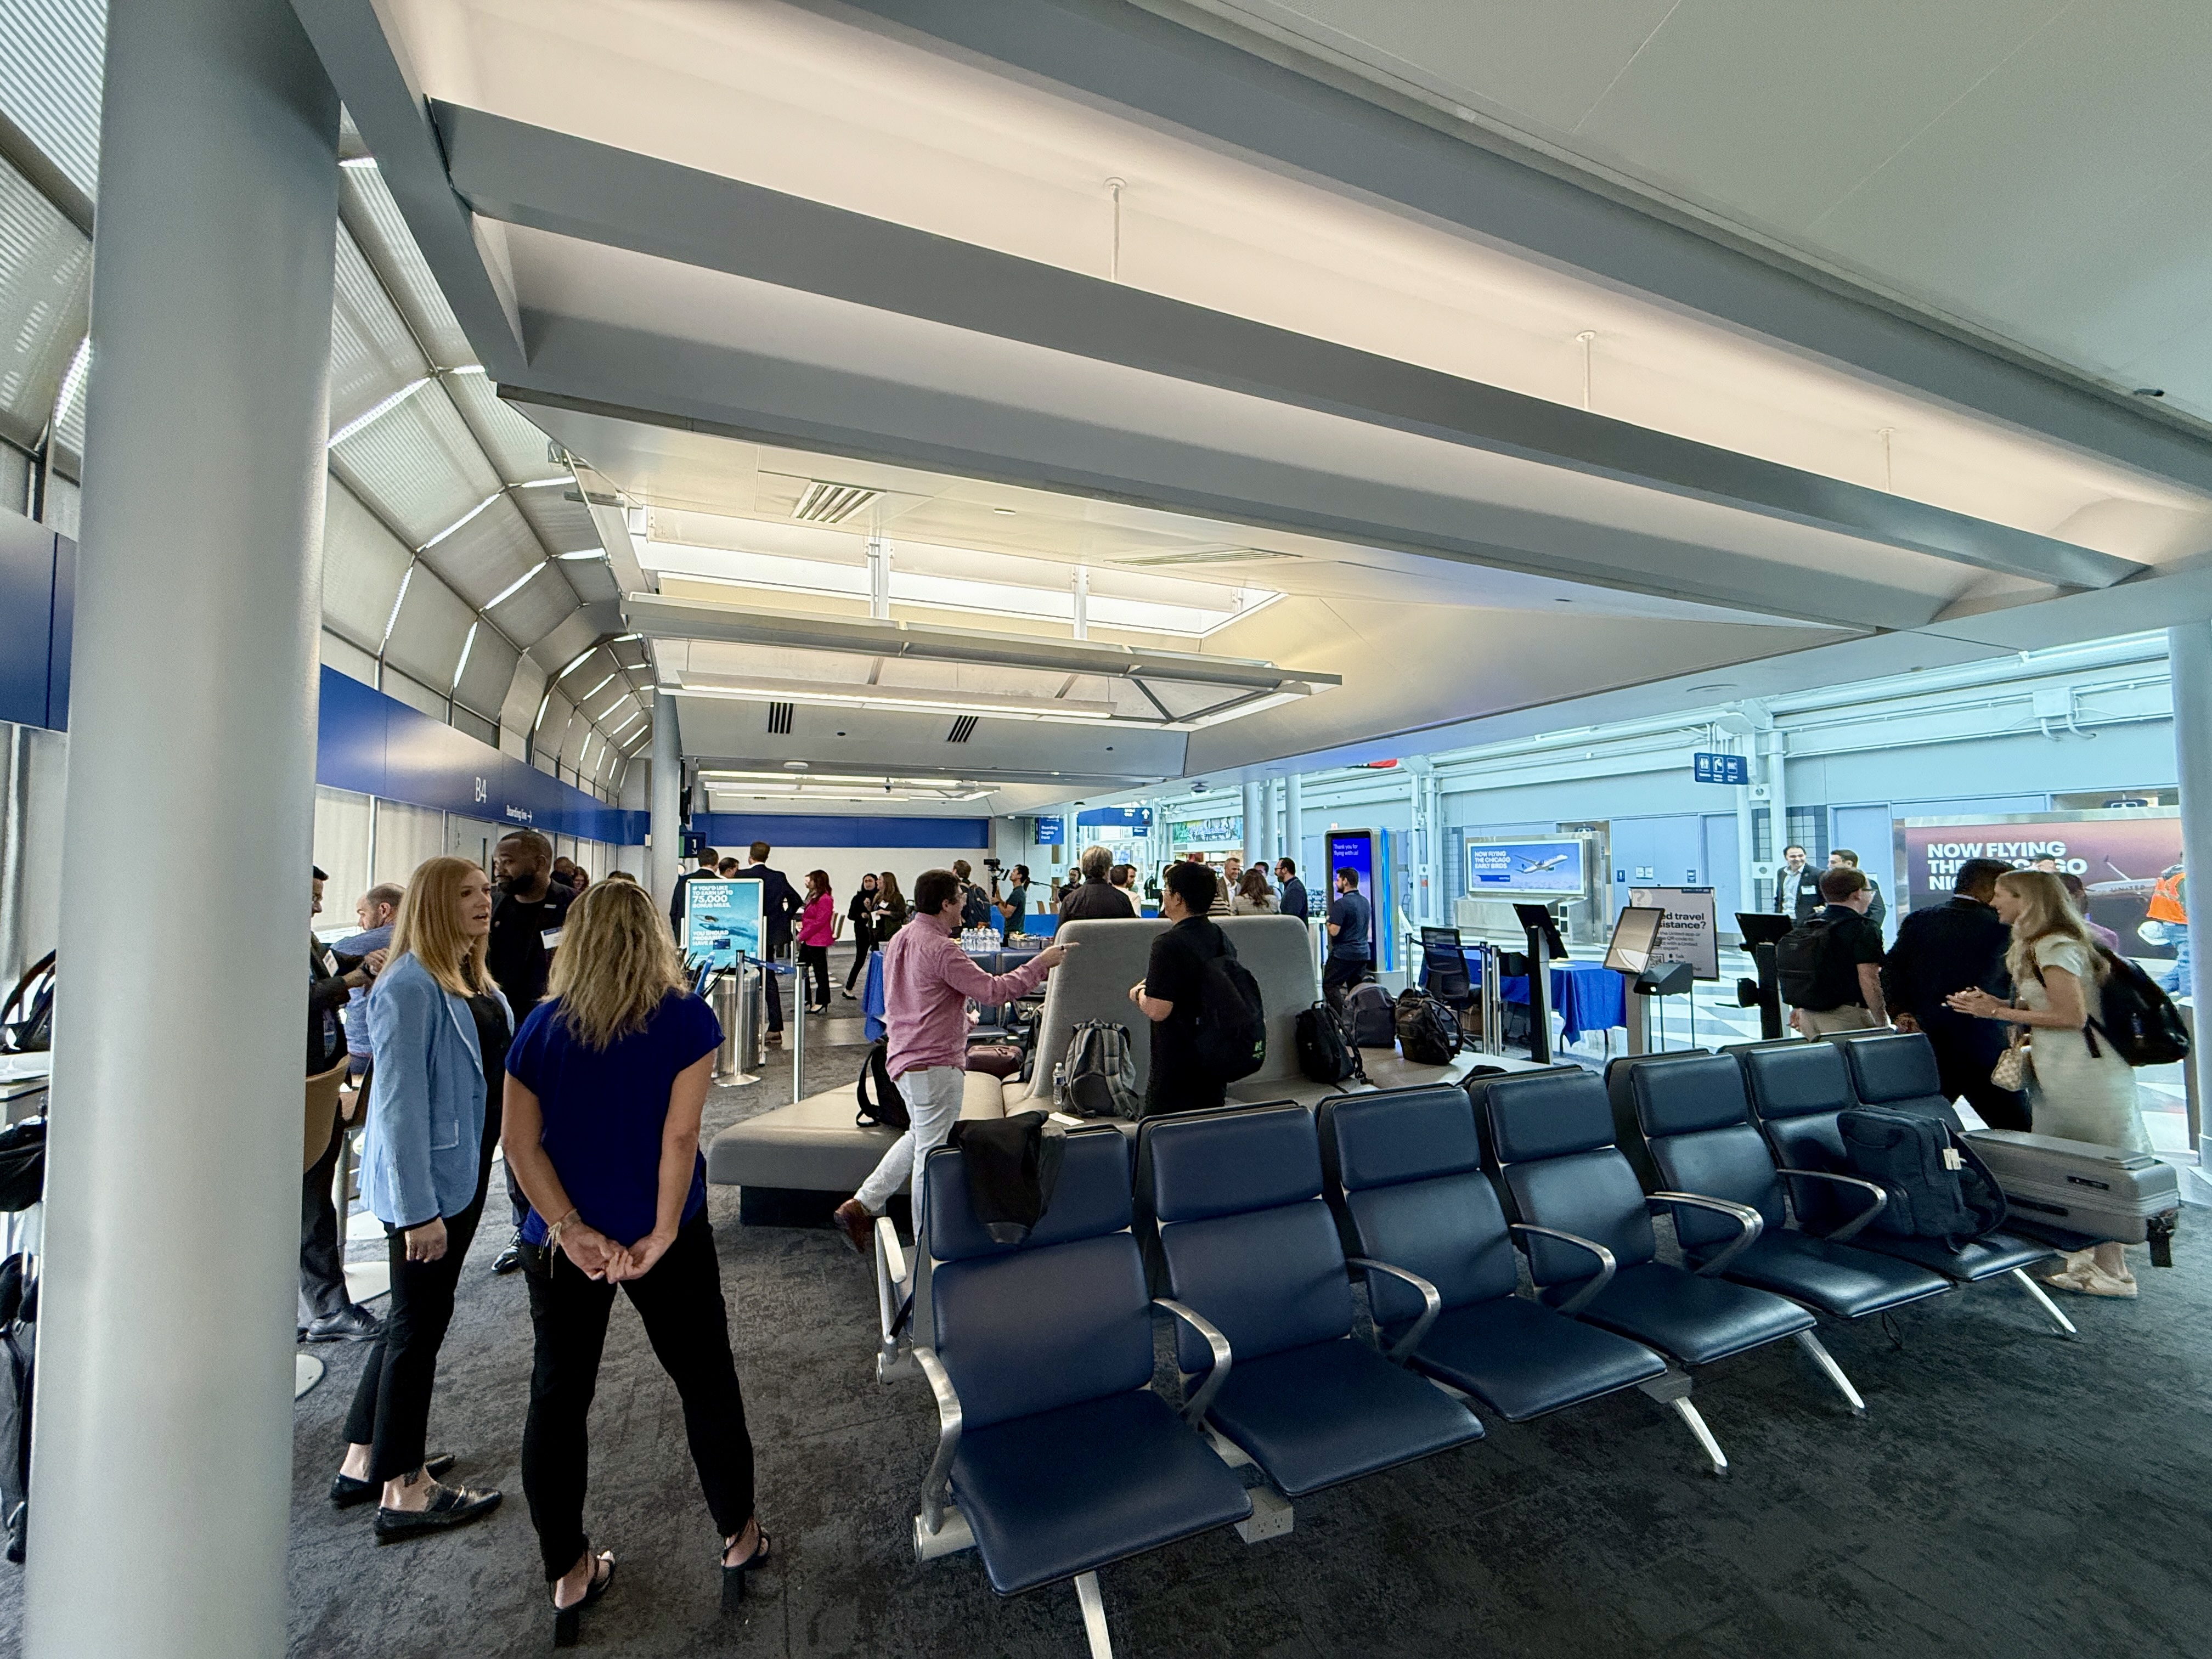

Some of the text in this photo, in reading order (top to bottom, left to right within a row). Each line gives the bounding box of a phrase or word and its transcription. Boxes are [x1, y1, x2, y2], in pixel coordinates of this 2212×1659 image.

[475, 777, 487, 803] B4
[692, 839, 697, 848] 1
[1927, 841, 2066, 857] NOW FLYING
[692, 895, 728, 904] 75,000
